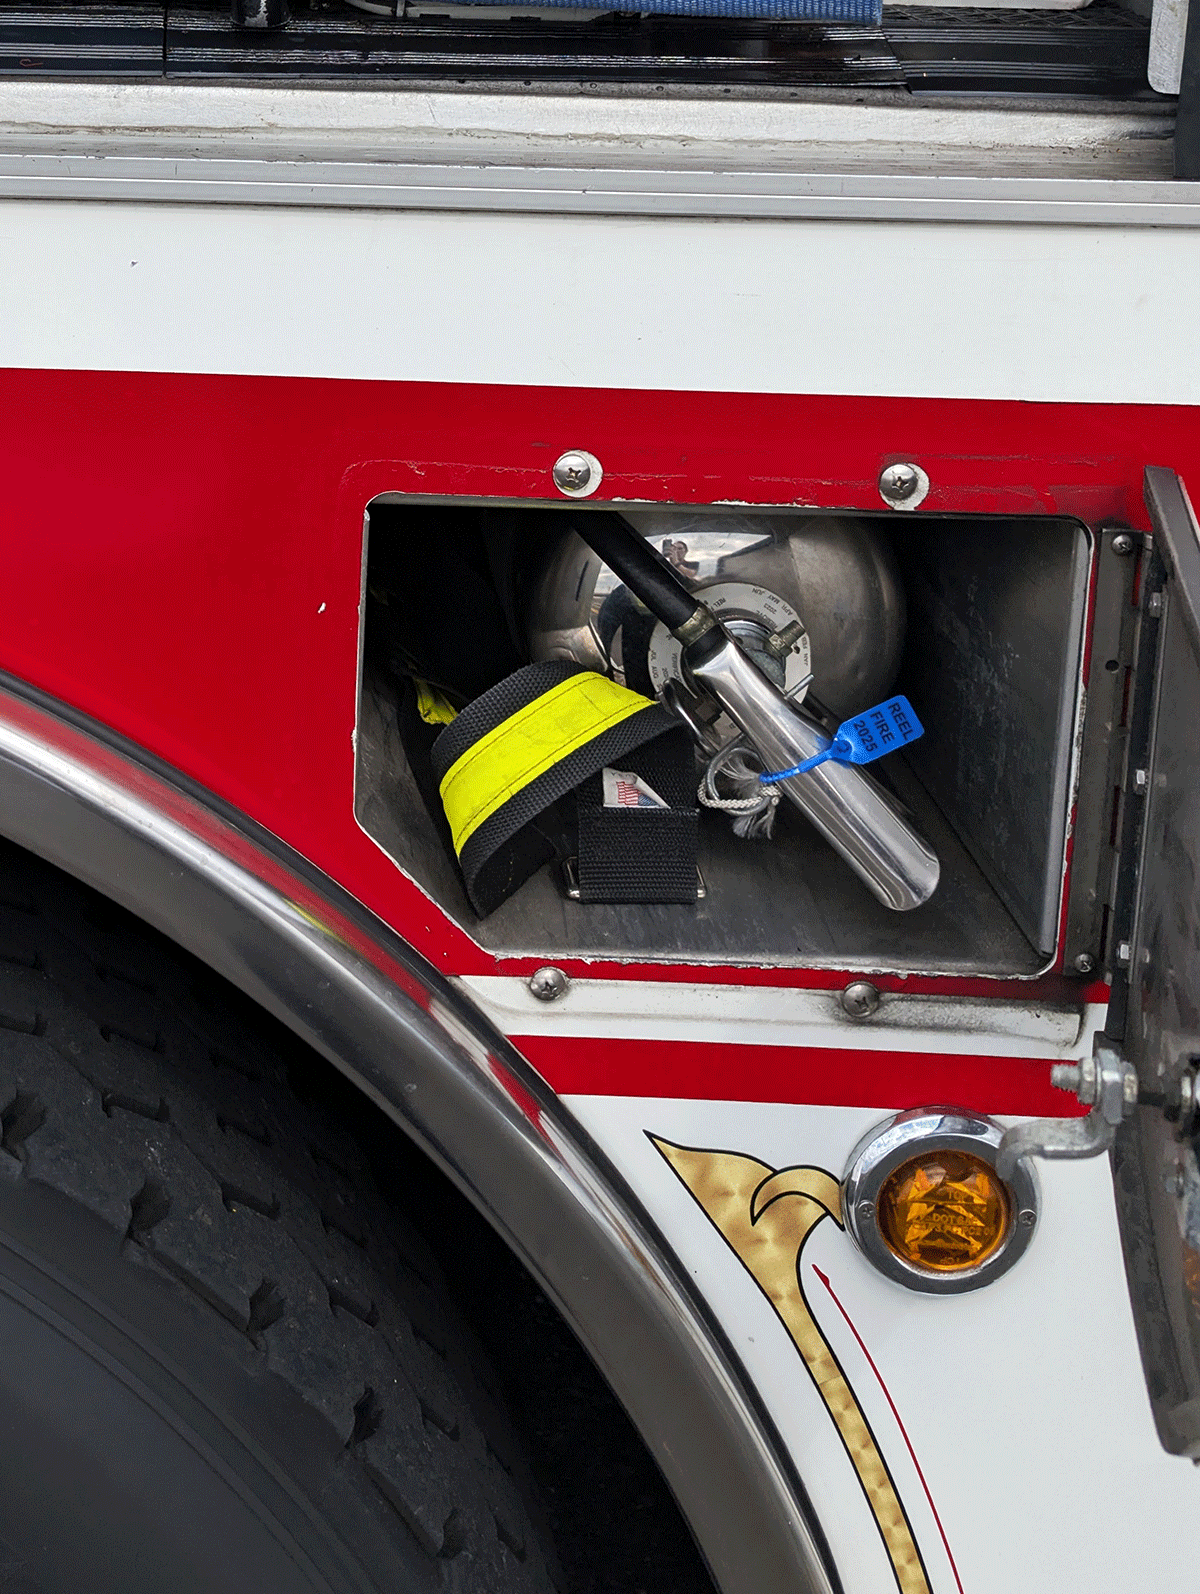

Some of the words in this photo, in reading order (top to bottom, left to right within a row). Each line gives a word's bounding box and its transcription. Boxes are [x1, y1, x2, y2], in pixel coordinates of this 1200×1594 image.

[751, 587, 766, 596] JUN
[767, 593, 781, 605] MAY
[781, 605, 794, 616] APR
[650, 649, 658, 662] JUL
[651, 665, 659, 679] AUG
[869, 711, 896, 745] FIRE
[887, 702, 914, 742] REEL
[853, 719, 879, 752] 2025
